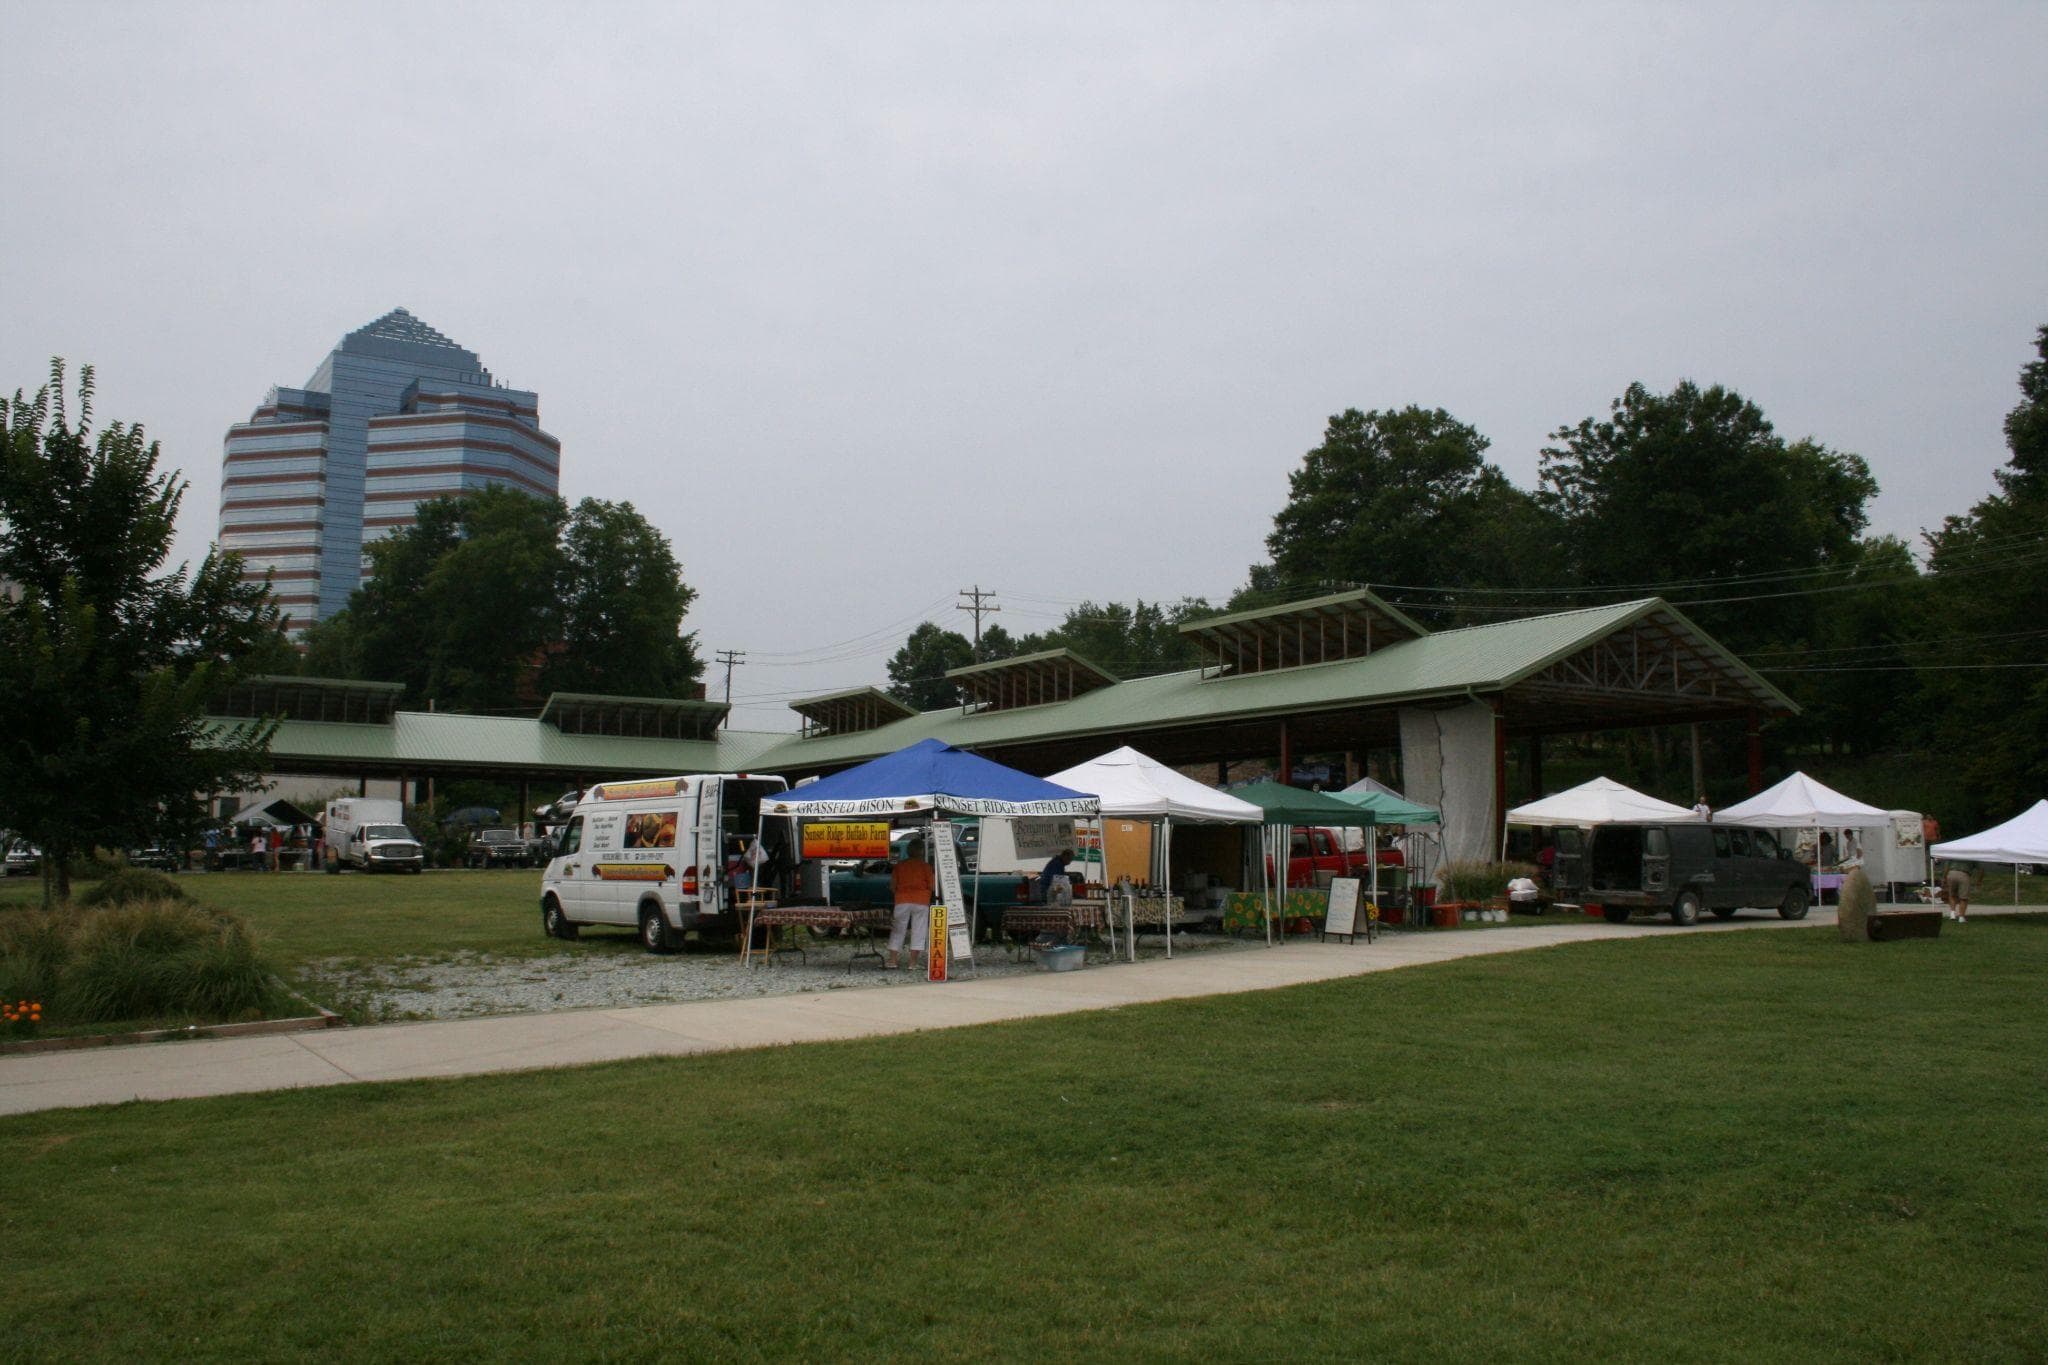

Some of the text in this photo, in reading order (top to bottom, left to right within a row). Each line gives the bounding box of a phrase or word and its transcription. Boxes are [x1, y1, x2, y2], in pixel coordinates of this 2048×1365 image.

[797, 799, 895, 814] GRASSFED BISON
[936, 796, 1100, 814] SUNSET RIDGE BUFFALO FARM
[805, 825, 887, 842] Sunset Ridge Buffalo Farm
[932, 908, 945, 979] BUFFALO
